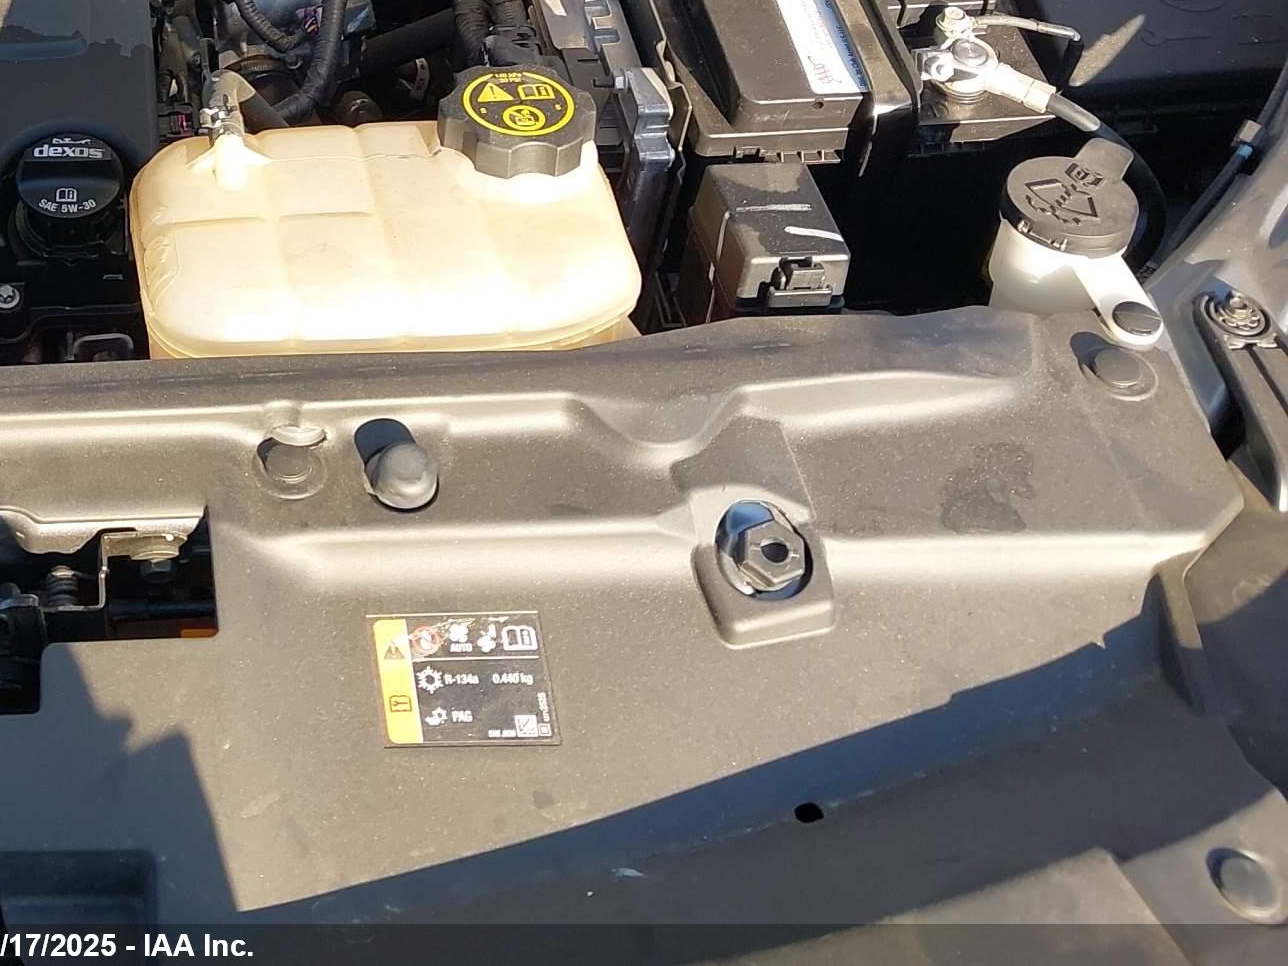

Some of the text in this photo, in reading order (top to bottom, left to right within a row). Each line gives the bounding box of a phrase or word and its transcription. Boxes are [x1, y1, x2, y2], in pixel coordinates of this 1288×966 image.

[33, 144, 105, 159] dexos
[38, 198, 97, 213] SAE 5W-30
[449, 642, 473, 653] AUTO
[443, 672, 480, 685] R-134a
[519, 672, 534, 686] kg
[451, 710, 474, 723] PAG
